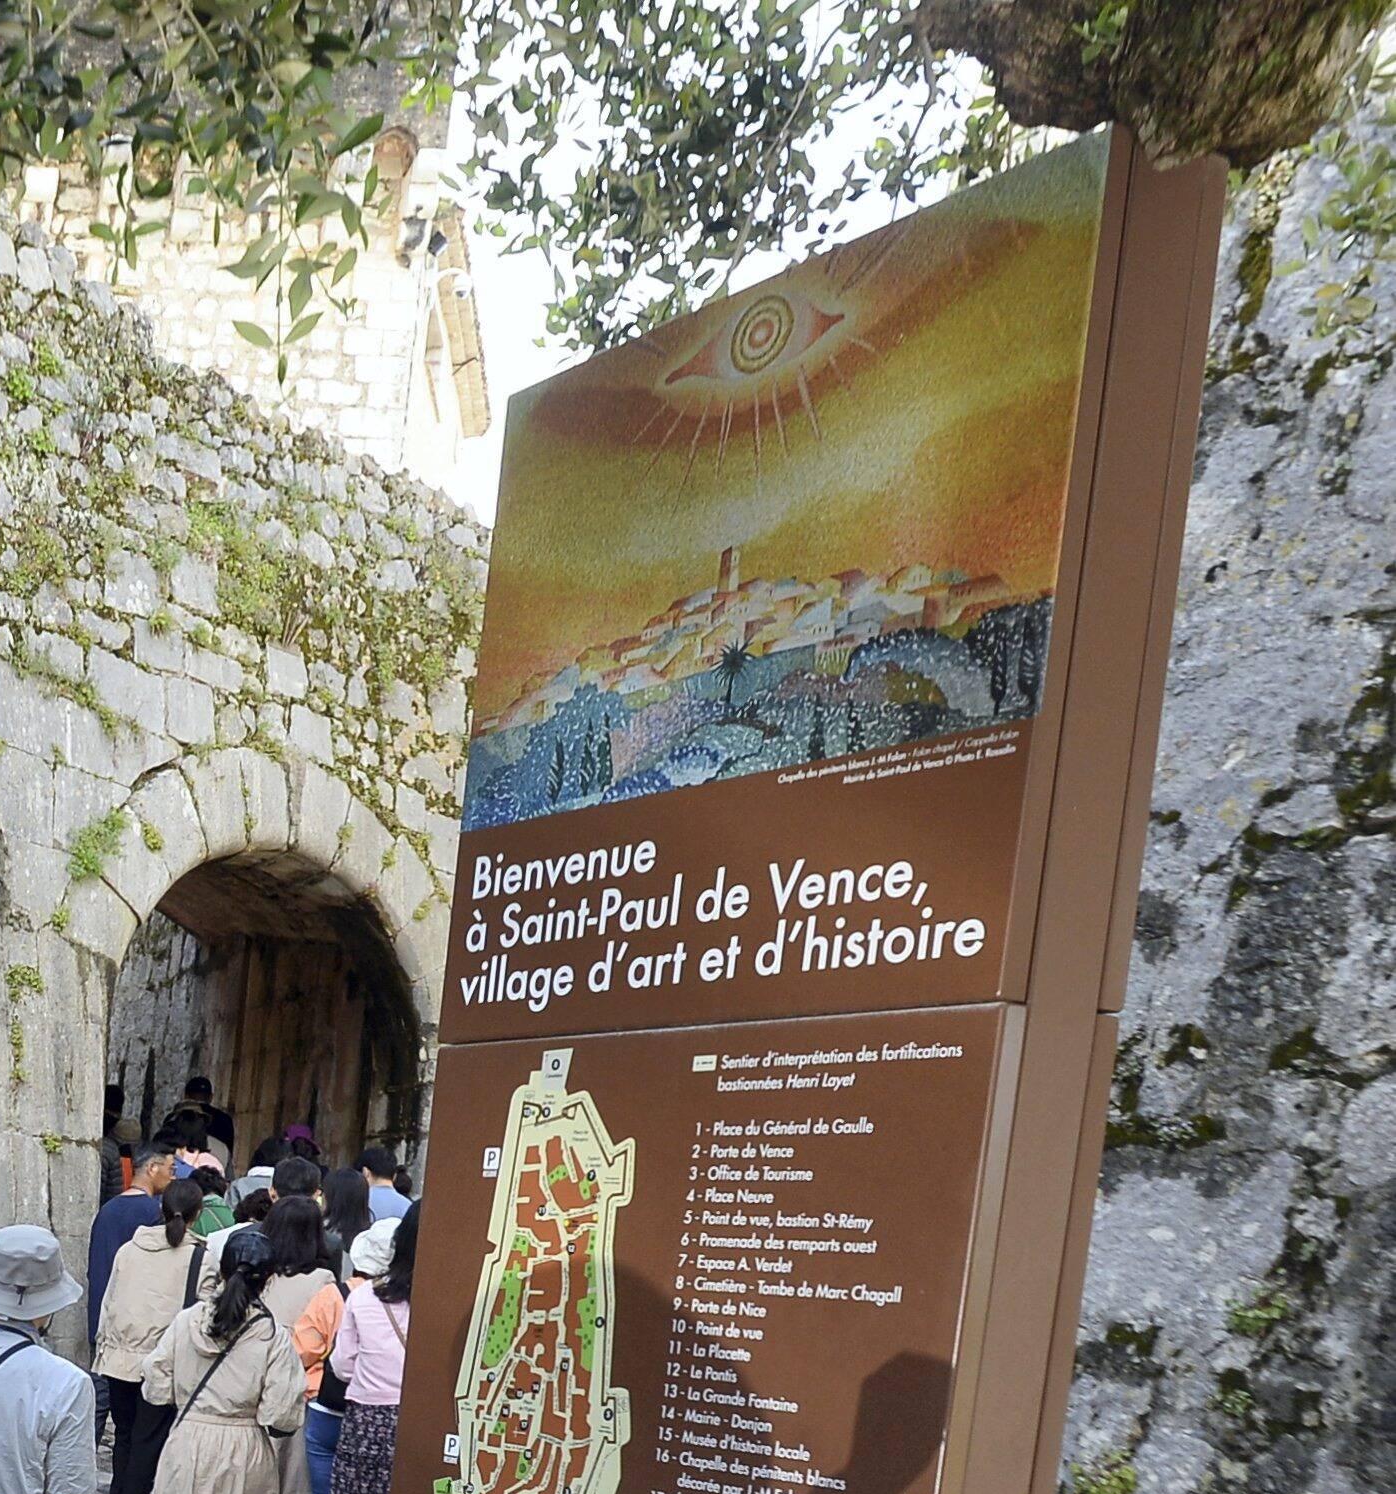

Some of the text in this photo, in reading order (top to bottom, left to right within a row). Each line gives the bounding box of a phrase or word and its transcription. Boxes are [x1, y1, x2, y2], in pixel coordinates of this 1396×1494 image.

[472, 838, 657, 899] Bienvenue
[465, 859, 927, 954] à Saint-Paul de Vence,
[459, 907, 986, 1013] village d'art et d'histoire
[721, 1054, 758, 1070] Sentier
[763, 1051, 852, 1069] d'interprétation
[856, 1047, 878, 1062] des
[881, 1043, 962, 1061] fortifications
[717, 1073, 856, 1092] bastionnées Henri Layet
[695, 1117, 874, 1136] 1 Place du Général de Gaulle
[692, 1144, 794, 1159] 2 Porte de Vence
[689, 1166, 813, 1181] 3 Office de Tourisme
[686, 1188, 774, 1203] 4 Place Neuve
[683, 1211, 873, 1233] 5 Point de vue, bastion St-Rémy
[681, 1233, 877, 1255] 6 Promenade des remparts ouest
[678, 1254, 687, 1267] 7
[697, 1258, 735, 1274] Espace
[755, 1257, 793, 1273] Verdet
[675, 1276, 902, 1306] 8 Cimetière Tombe de Marc Chagall
[673, 1297, 767, 1318] 9 Porte de Nice
[671, 1319, 764, 1341] 10 Point de vue
[669, 1340, 751, 1362] 11 La Placette
[666, 1362, 680, 1377] 12
[691, 1365, 702, 1380] Le
[663, 1384, 799, 1413] 13 La Grande Fontaine
[661, 1405, 773, 1434] 14 Mairie Donjon
[658, 1427, 672, 1441] 15
[681, 1429, 717, 1448] Musée
[774, 1440, 811, 1462] locale
[655, 1447, 669, 1463] 16
[679, 1451, 727, 1474] Chapelle
[729, 1458, 750, 1476] des
[806, 1468, 846, 1491] blancs
